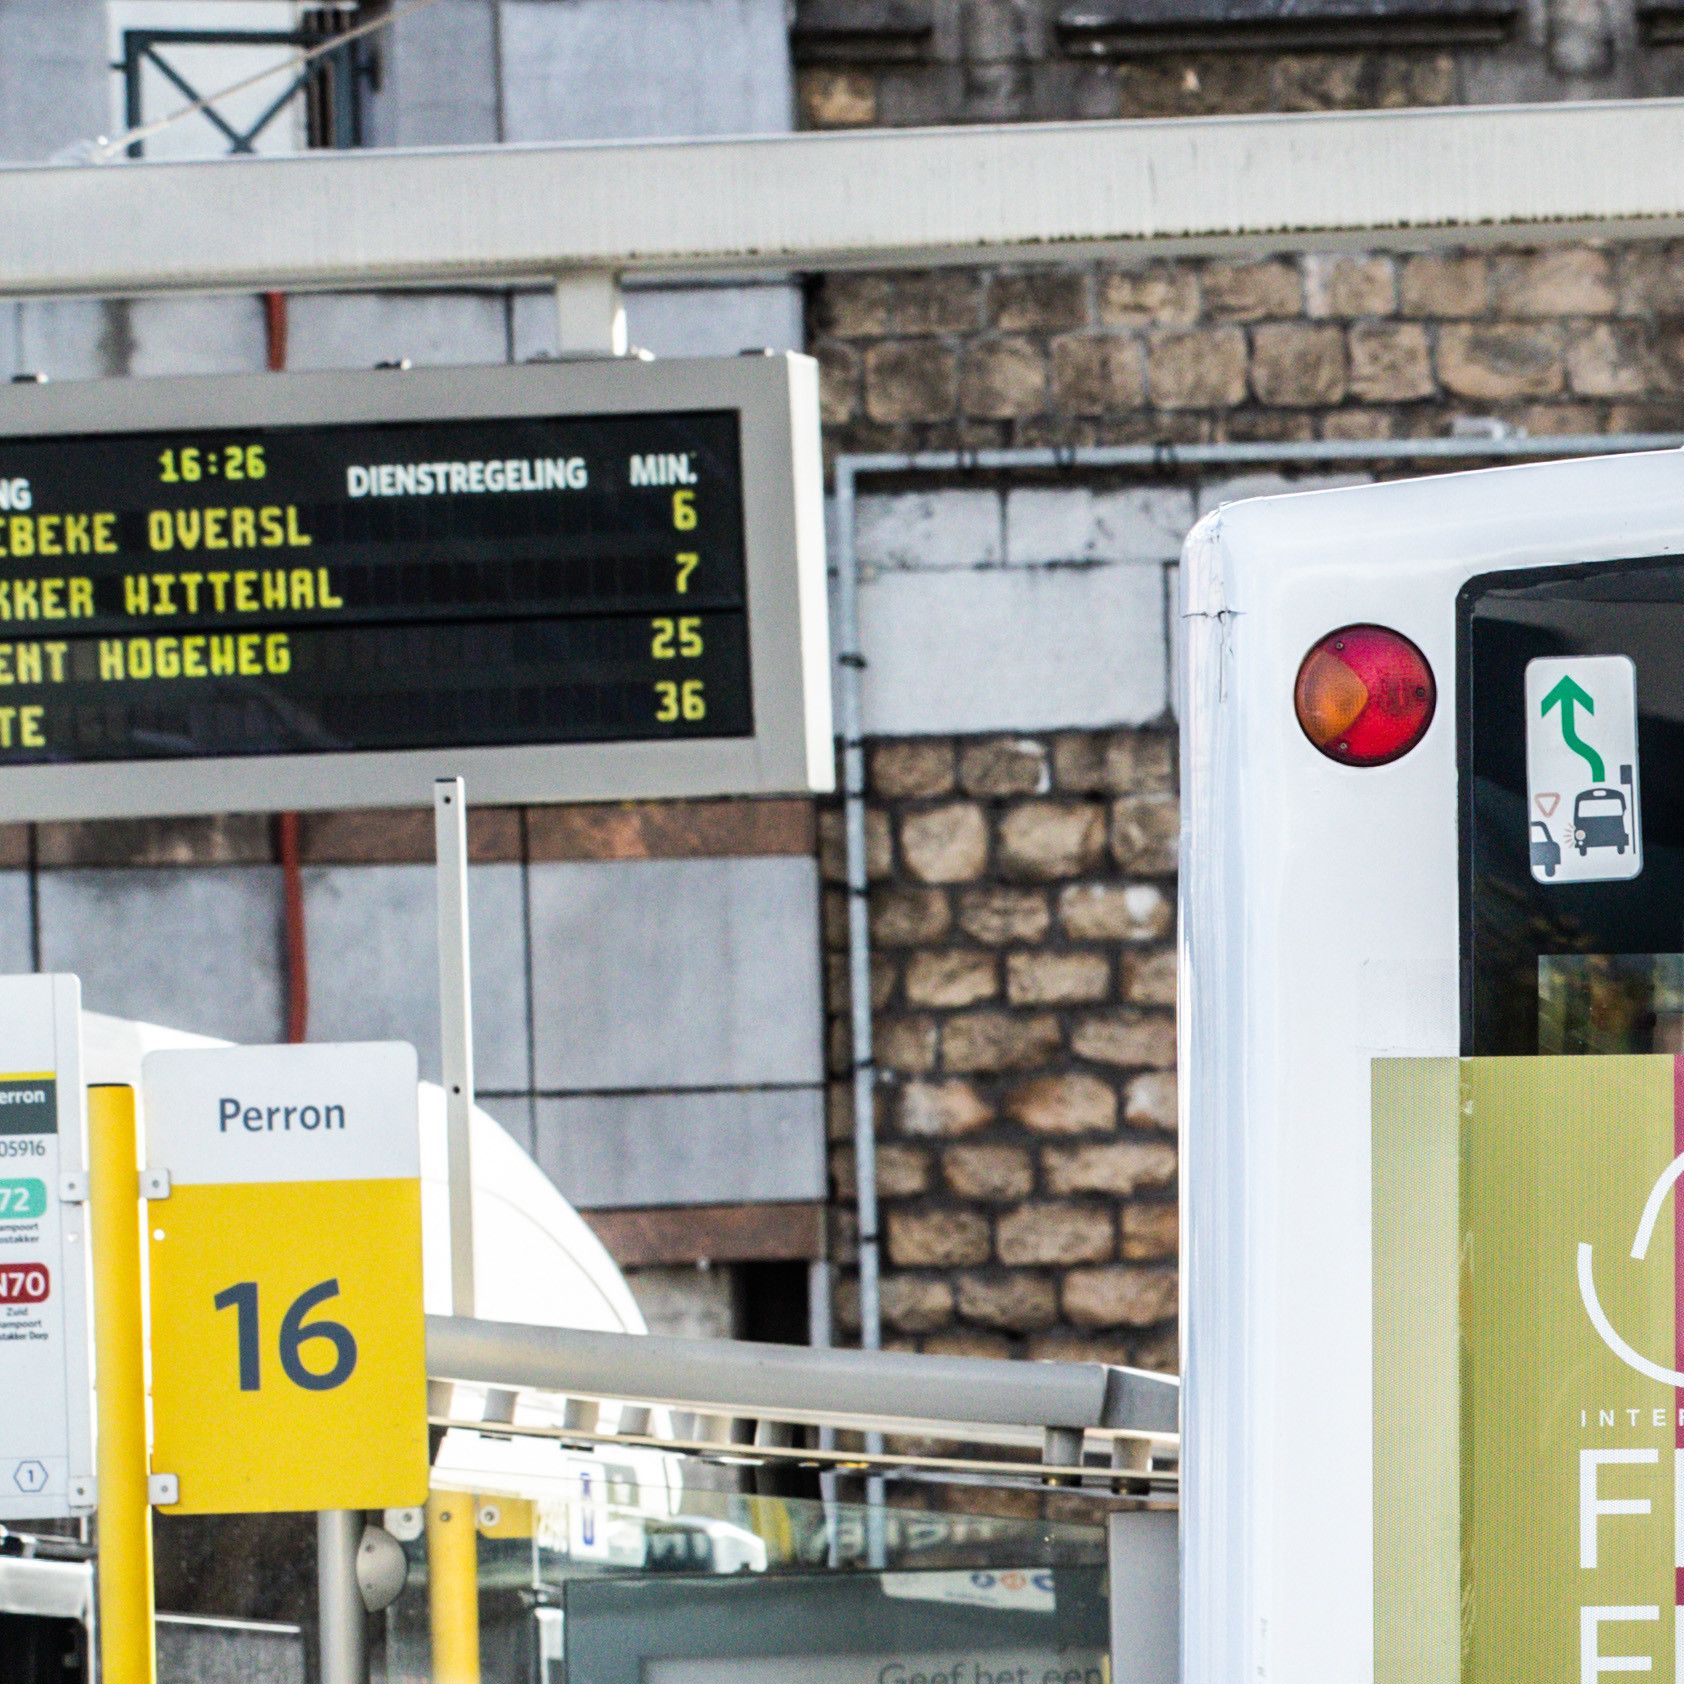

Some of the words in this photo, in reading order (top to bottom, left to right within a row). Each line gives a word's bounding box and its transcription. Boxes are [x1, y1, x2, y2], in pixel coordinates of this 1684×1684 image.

[159, 445, 266, 483] 16:26
[346, 457, 588, 498] DIENSTREGELING
[630, 453, 698, 486] MIN.
[0, 512, 118, 558] BEKE
[149, 505, 312, 551] OVERSL
[672, 489, 698, 531] 6
[123, 567, 343, 615] WITTEWAL
[674, 553, 700, 595] 7
[100, 633, 291, 681] HOGEWEG
[651, 618, 704, 660] 25
[655, 681, 706, 723] 36
[219, 1098, 347, 1132] Perron
[214, 1278, 358, 1392] 16
